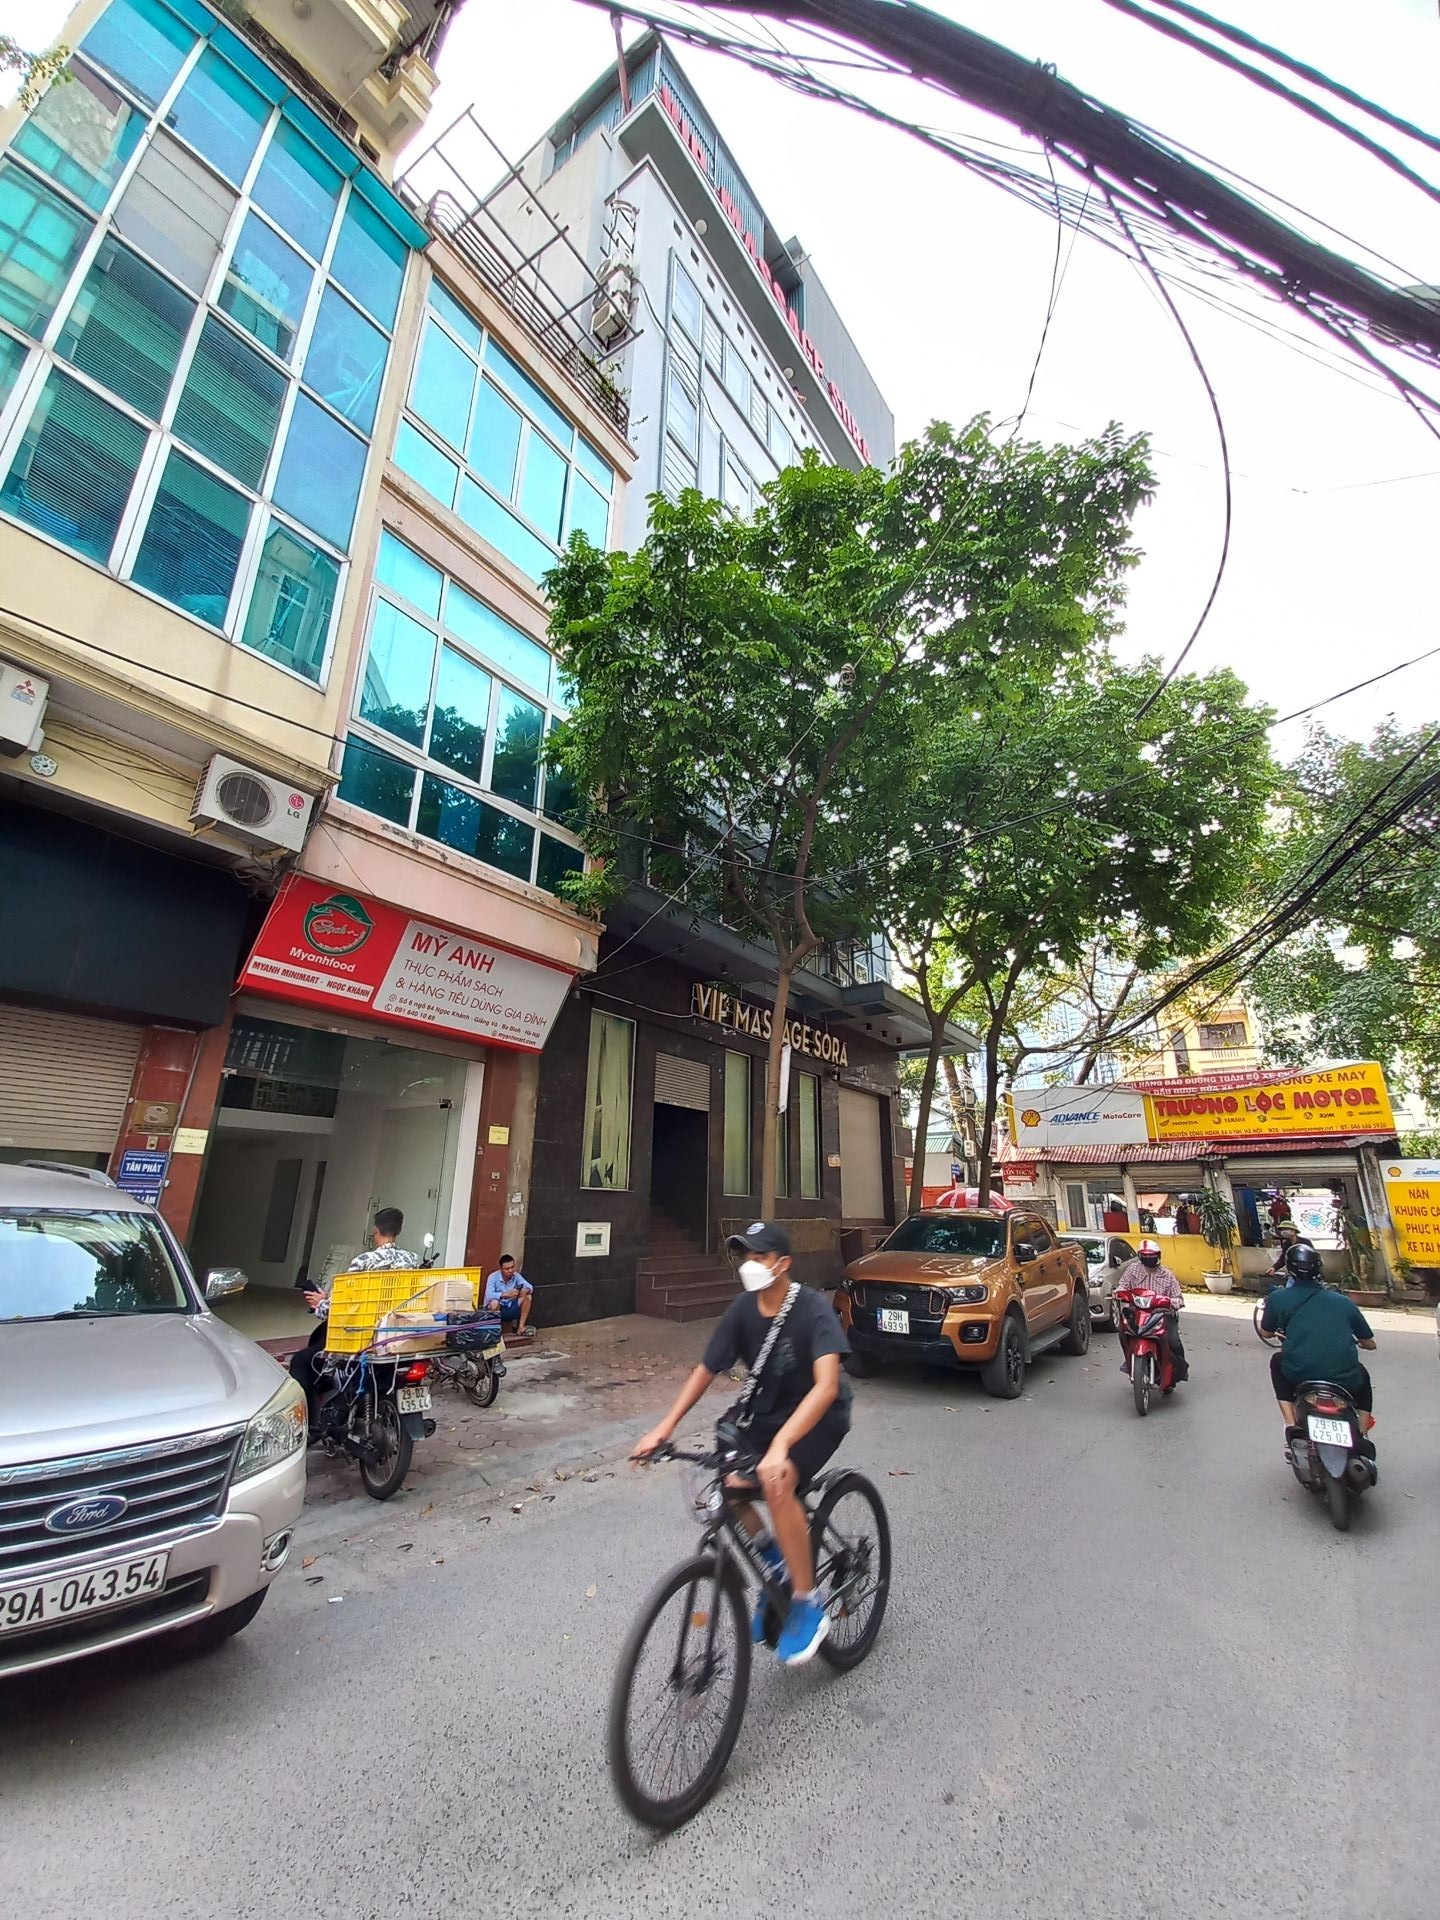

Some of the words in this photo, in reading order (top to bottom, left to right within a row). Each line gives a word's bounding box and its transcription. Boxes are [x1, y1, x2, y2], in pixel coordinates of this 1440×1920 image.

[287, 808, 300, 819] LG
[411, 931, 449, 957] MỸ
[448, 946, 496, 974] ANH
[289, 947, 356, 973] Myanhfood
[281, 968, 320, 984] MINIMART
[395, 977, 405, 989] &
[408, 980, 446, 1000] HÀNG
[504, 1008, 522, 1021] GIA
[736, 999, 811, 1053] MASAGE
[814, 1029, 848, 1067] SORA
[1317, 1073, 1333, 1083] XE
[1294, 1087, 1380, 1110] MOTOR
[1049, 1111, 1101, 1123] ADVANCE
[1102, 1112, 1142, 1120] MotoCare
[142, 1163, 162, 1173] PHÁT
[1394, 1205, 1428, 1217] KHUNG
[1406, 1241, 1419, 1252] XE
[1420, 1241, 1435, 1253] TAI
[888, 1310, 903, 1321] 29H
[66, 1502, 109, 1525] Ford
